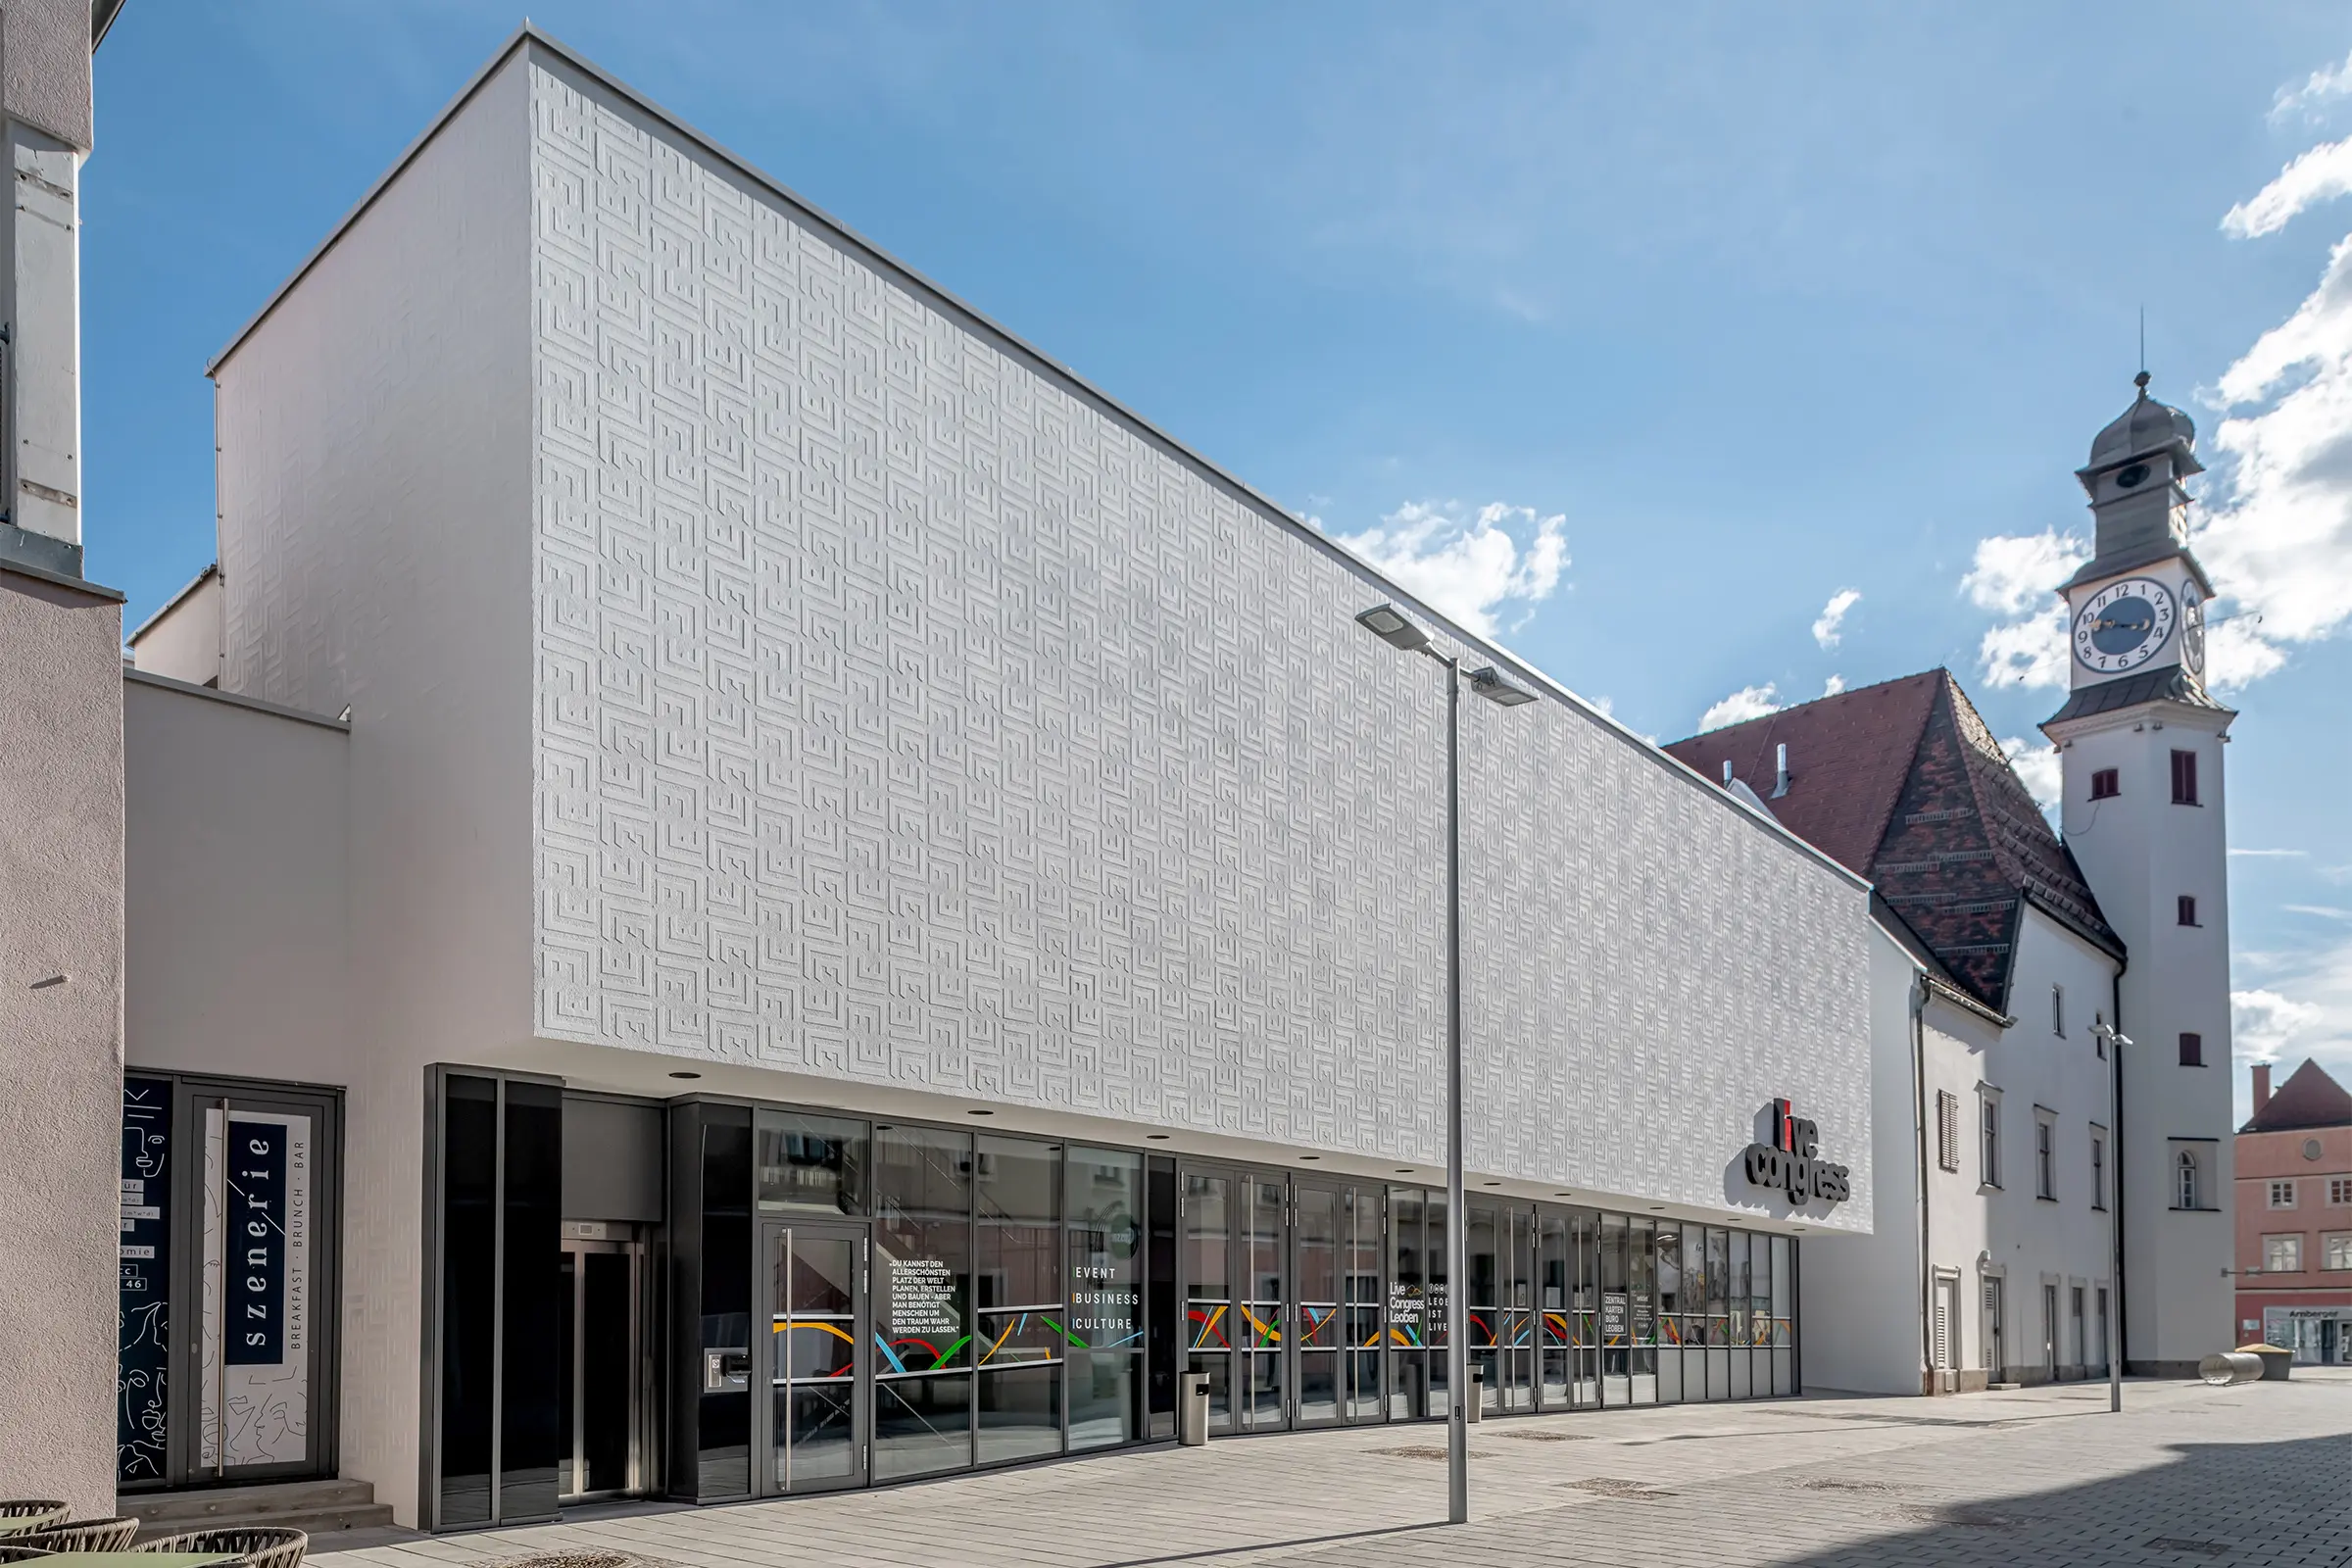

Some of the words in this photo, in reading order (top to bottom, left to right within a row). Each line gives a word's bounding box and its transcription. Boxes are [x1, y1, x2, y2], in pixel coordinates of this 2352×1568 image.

[2116, 584, 2130, 598] 12
[2140, 584, 2145, 595] 1
[2097, 595, 2106, 608] 11
[2154, 591, 2164, 605] 2
[2082, 612, 2095, 625] 10
[2159, 608, 2170, 621] 3
[2078, 630, 2088, 643] 9
[2153, 626, 2164, 639] 4
[2083, 646, 2092, 659] 8
[2138, 645, 2148, 659] 5
[2097, 656, 2106, 668] 7
[2118, 655, 2129, 667] 6
[294, 1142, 304, 1168] BAR
[1745, 1143, 1850, 1205] congress
[293, 1189, 303, 1248] BRUNCH
[242, 1139, 270, 1347] szenerie
[1075, 1267, 1115, 1279] EVENT
[125, 1280, 142, 1289] 46
[1390, 1282, 1405, 1296] Live
[1075, 1293, 1139, 1305] BUSINESS
[1390, 1297, 1425, 1312] Congress
[1605, 1296, 1626, 1304] ZENTRAL
[291, 1268, 302, 1349] BREAKFAST
[1428, 1309, 1442, 1318] IST
[1390, 1310, 1419, 1323] Leoben
[1075, 1318, 1132, 1329] CULTURE
